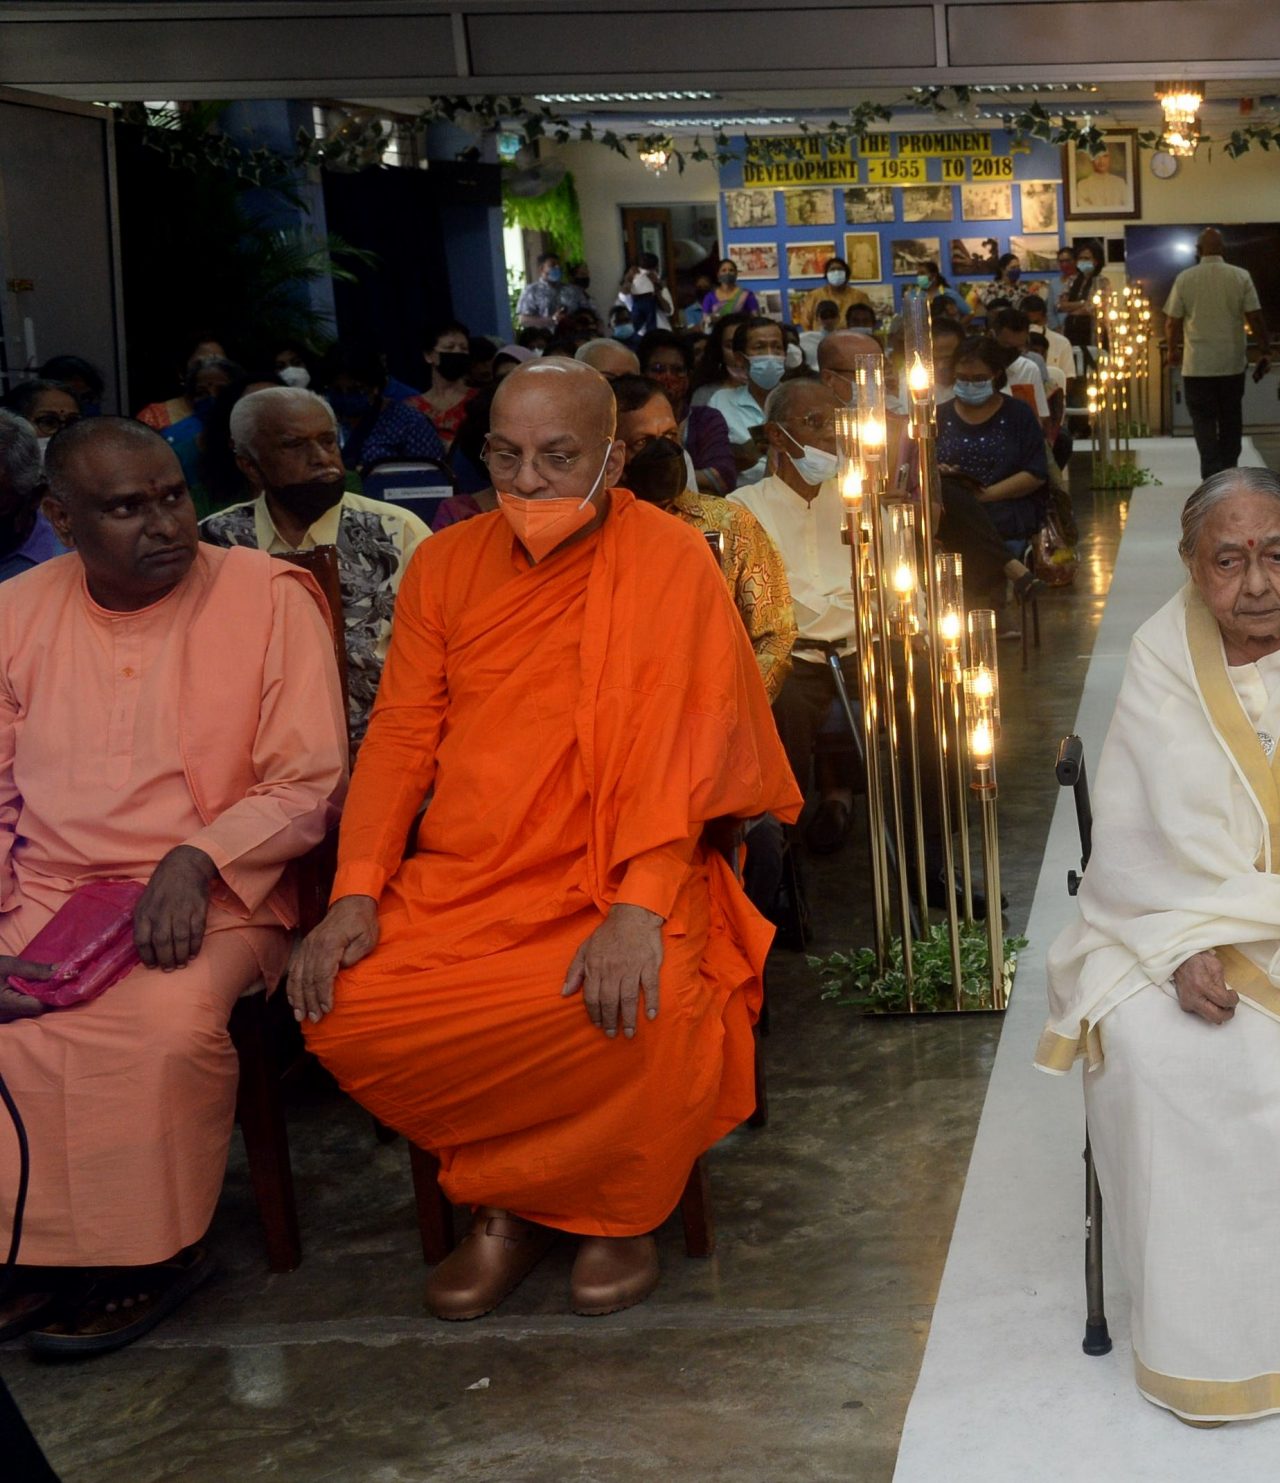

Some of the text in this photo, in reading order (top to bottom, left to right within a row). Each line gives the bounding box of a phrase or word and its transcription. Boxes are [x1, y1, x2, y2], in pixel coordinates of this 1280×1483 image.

[859, 133, 889, 152] THE
[898, 132, 991, 153] PROMINENT
[744, 160, 857, 182] DEVELOPMENT
[880, 160, 920, 178] 1955
[942, 159, 965, 177] TO
[972, 157, 1013, 177] 2018
